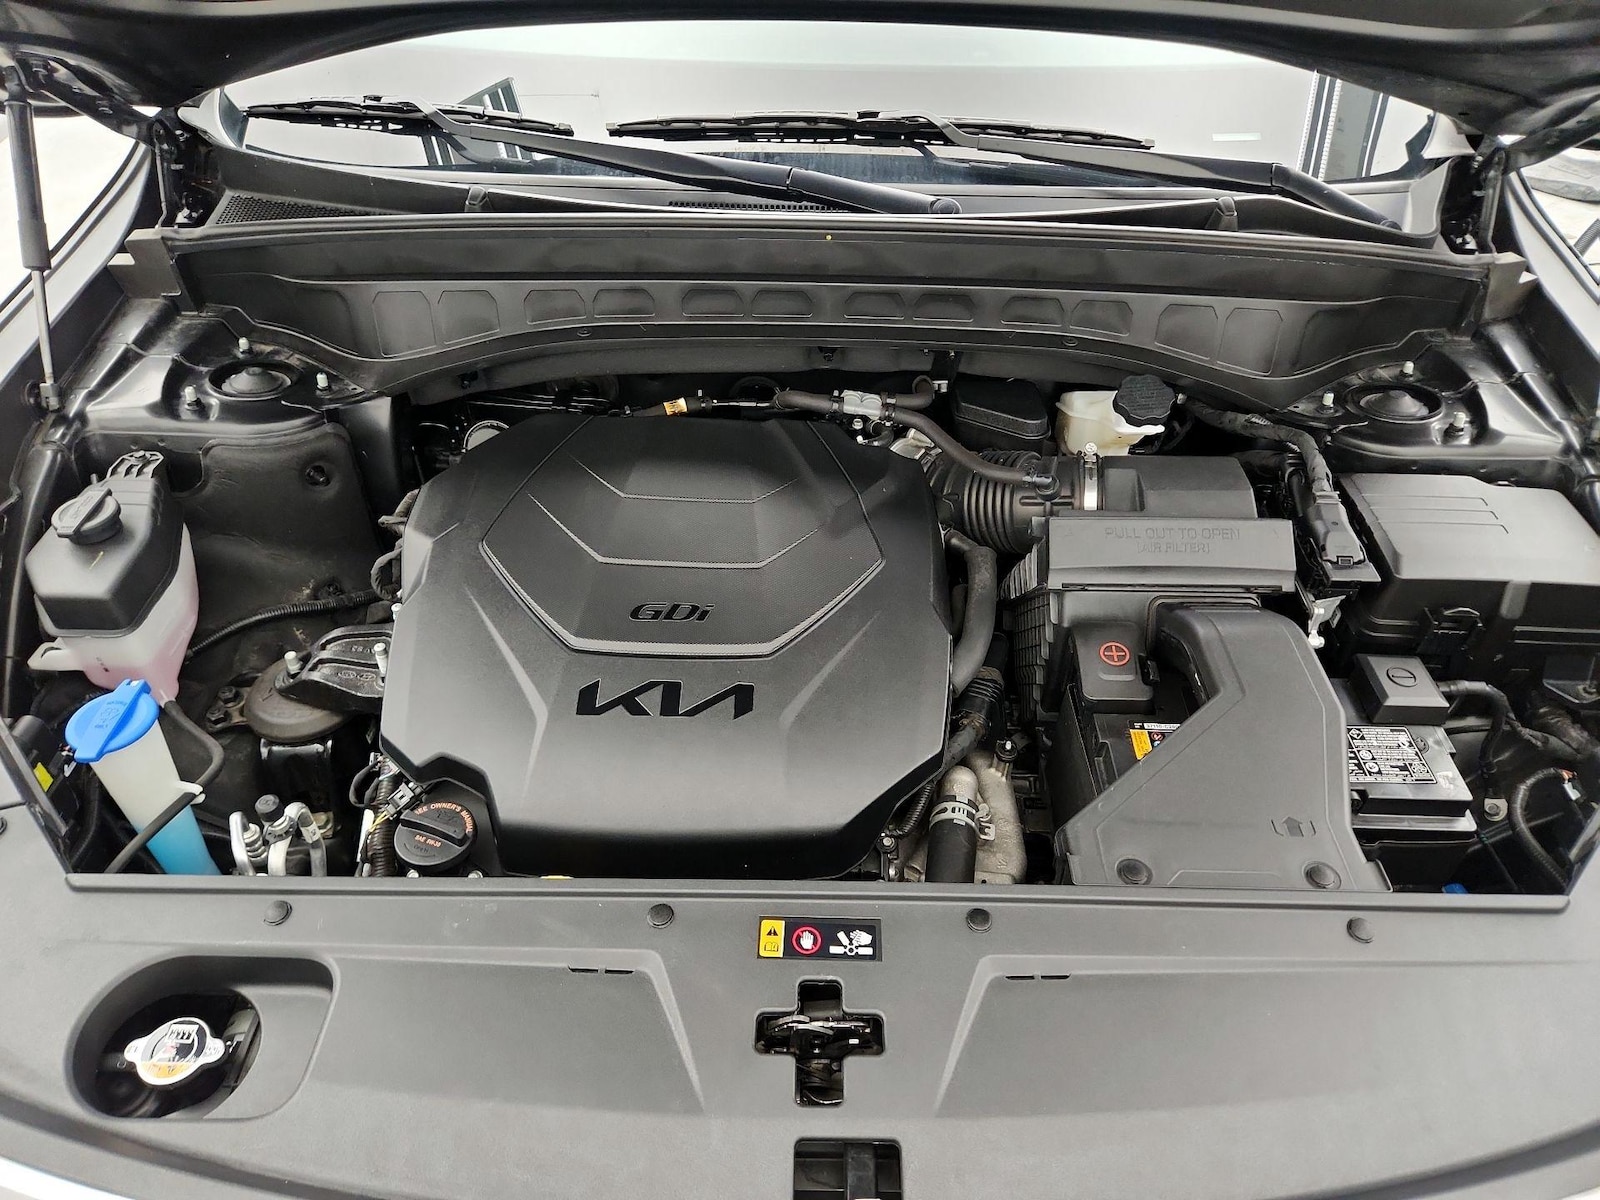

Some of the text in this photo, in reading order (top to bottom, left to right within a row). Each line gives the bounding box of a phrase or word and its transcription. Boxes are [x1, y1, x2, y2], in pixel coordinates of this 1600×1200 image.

[1105, 527, 1240, 540] PULL OUT TO OPEN
[629, 601, 716, 623] GDi
[576, 678, 755, 720] KIA
[414, 802, 474, 833] SEE OWNER'S MANUAL
